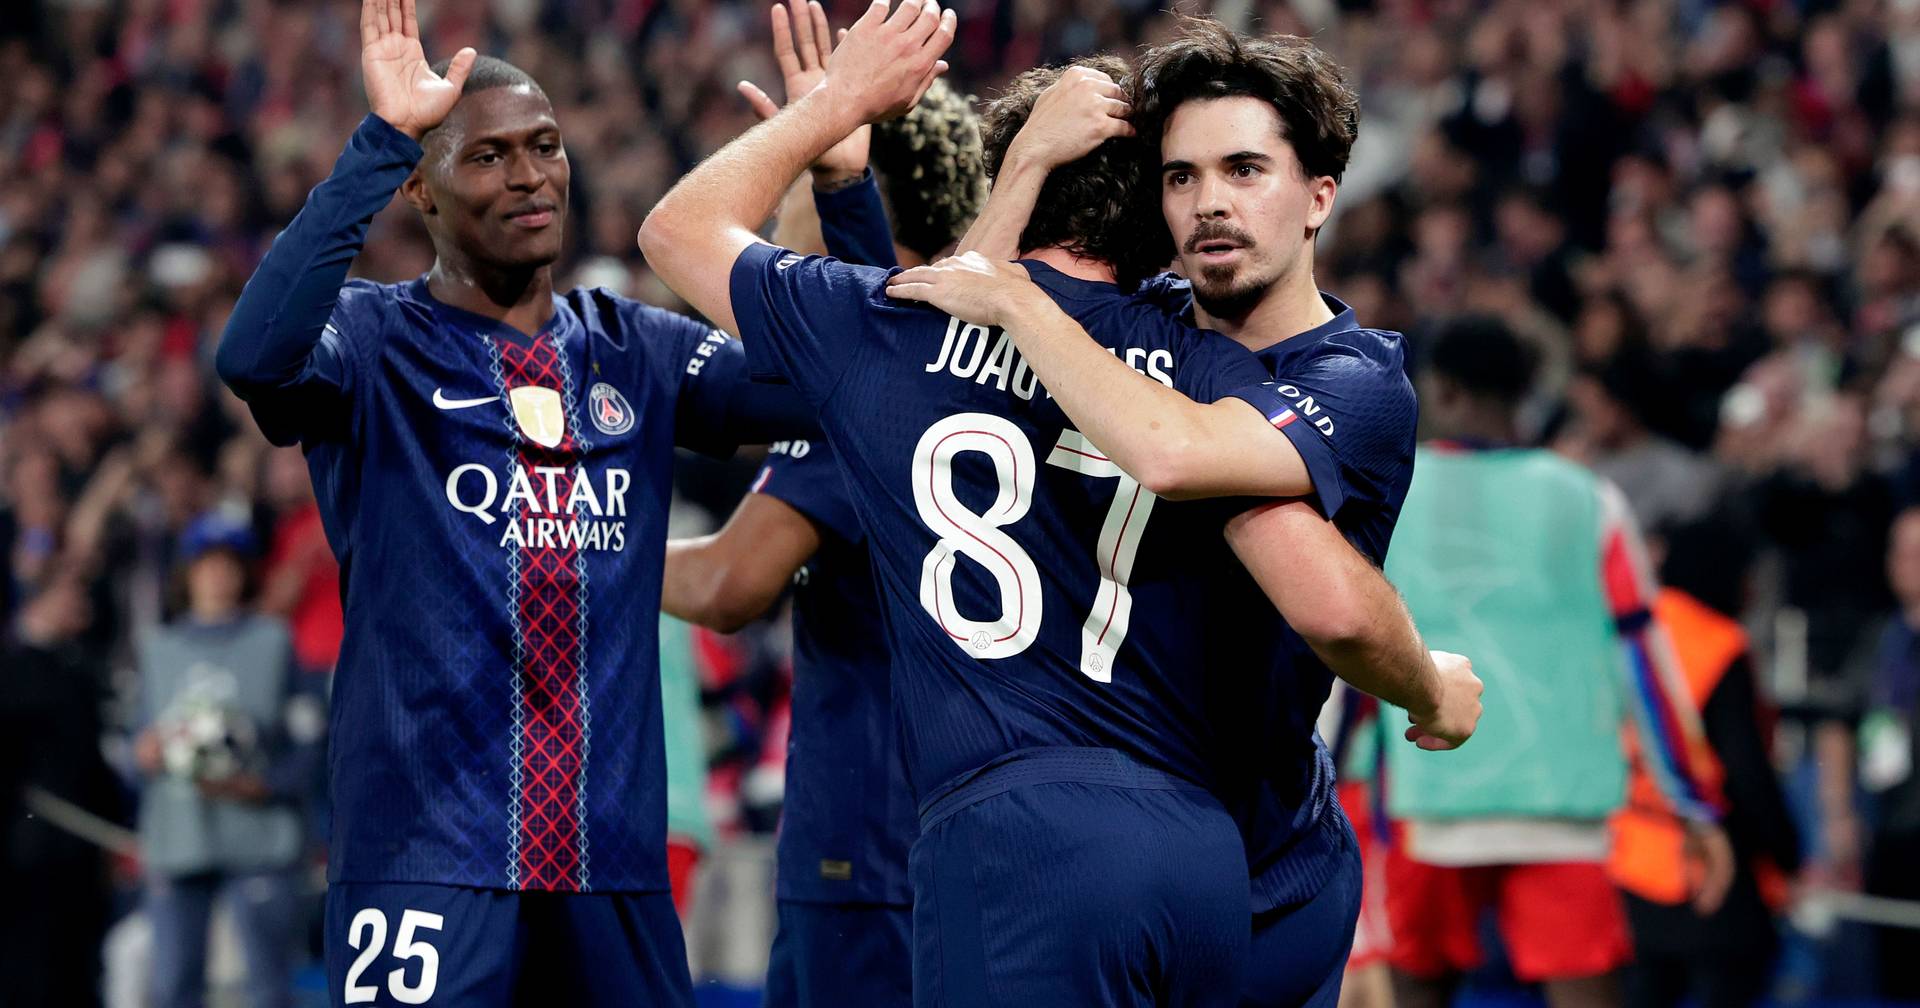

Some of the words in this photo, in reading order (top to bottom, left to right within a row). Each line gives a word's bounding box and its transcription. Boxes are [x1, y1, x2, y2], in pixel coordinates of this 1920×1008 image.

[446, 463, 631, 525] QATAR
[500, 518, 626, 552] AIRWAYS
[911, 412, 1157, 684] 87
[345, 907, 444, 1005] 25
